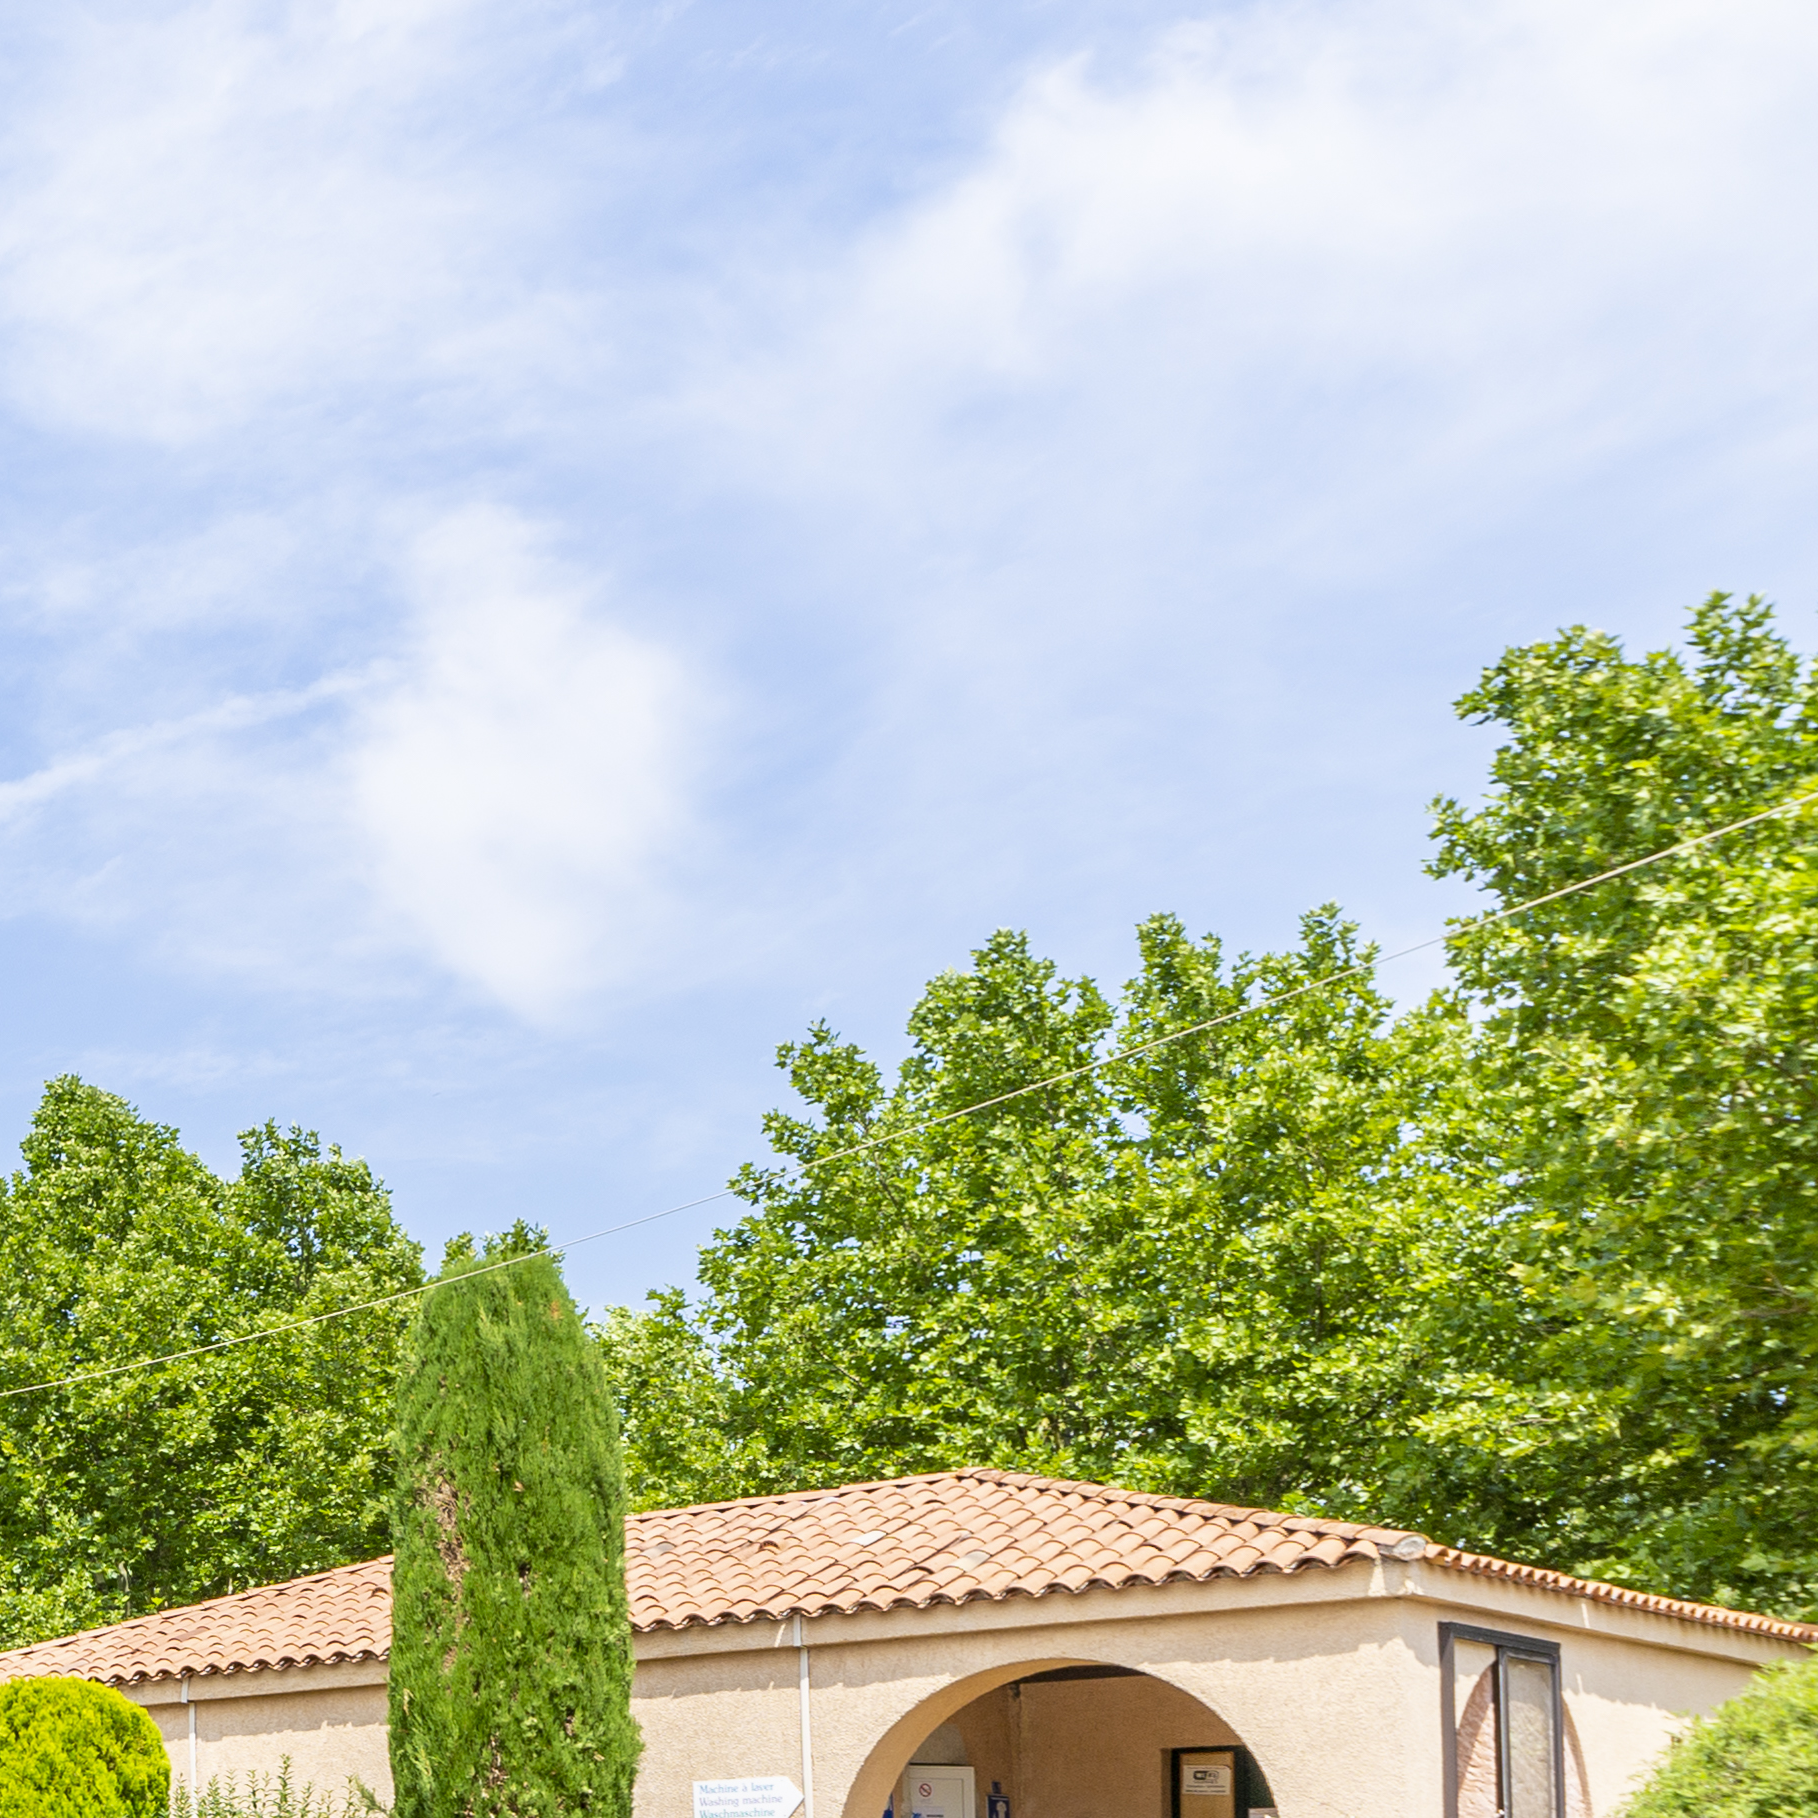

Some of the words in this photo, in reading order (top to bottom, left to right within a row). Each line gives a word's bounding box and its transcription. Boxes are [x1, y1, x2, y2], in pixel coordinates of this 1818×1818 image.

[699, 1784, 739, 1794] Machine
[751, 1782, 774, 1791] laver
[699, 1796, 739, 1807] Washing
[743, 1795, 783, 1805] machine
[699, 1808, 775, 1818] Waschmaschine
